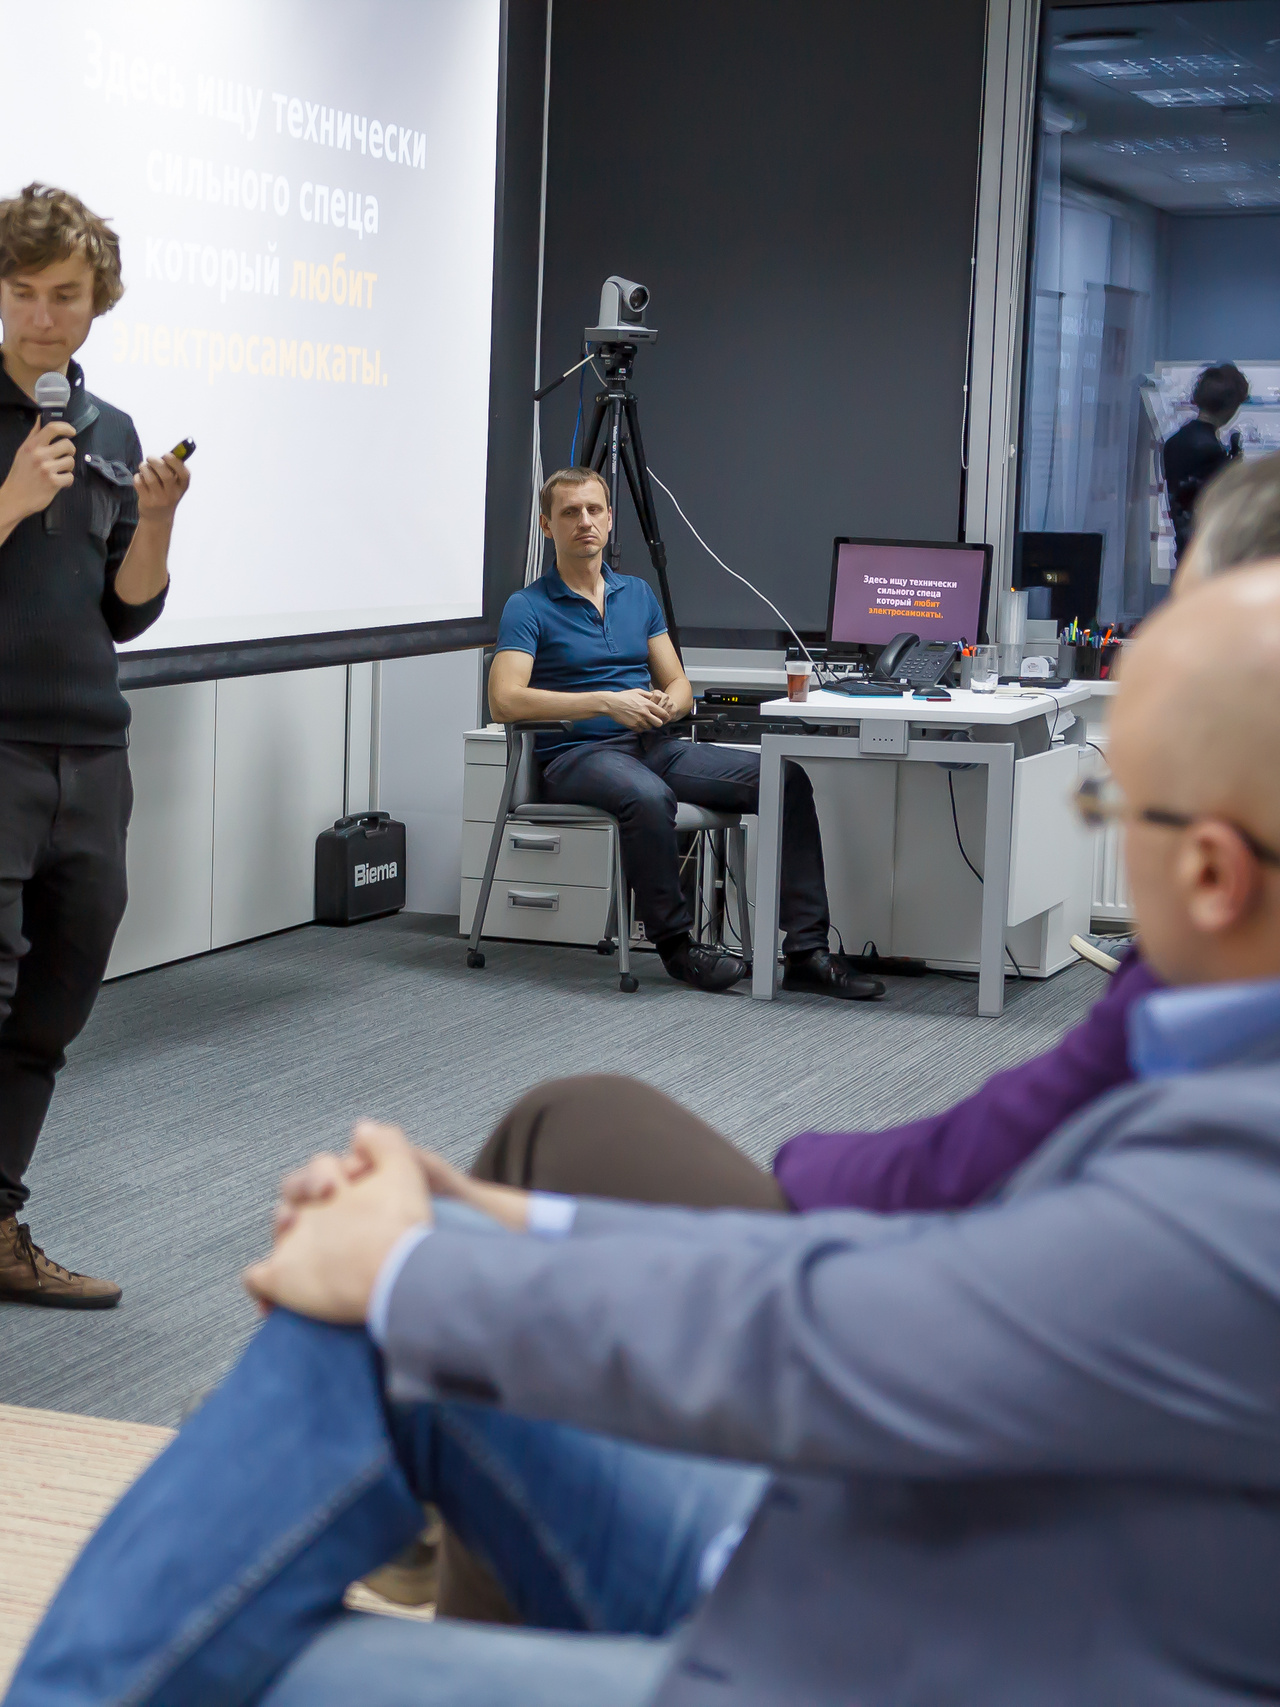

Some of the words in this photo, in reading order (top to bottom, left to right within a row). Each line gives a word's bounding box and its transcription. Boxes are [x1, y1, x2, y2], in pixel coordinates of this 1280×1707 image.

[83, 28, 186, 110] Здесь
[197, 73, 263, 141] ищу
[272, 91, 427, 170] технически
[145, 148, 290, 217] сильного
[299, 180, 380, 241] спеца
[145, 237, 280, 304] который
[289, 252, 378, 310] любит
[111, 320, 389, 387] электросамокаты.
[863, 575, 888, 585] Здесь
[889, 577, 907, 587] ищу
[909, 579, 958, 589] технически
[877, 587, 915, 596] сильного
[916, 589, 941, 599] спеца
[868, 607, 944, 619] электросамокаты.
[876, 597, 912, 607] который
[913, 599, 941, 608] любит
